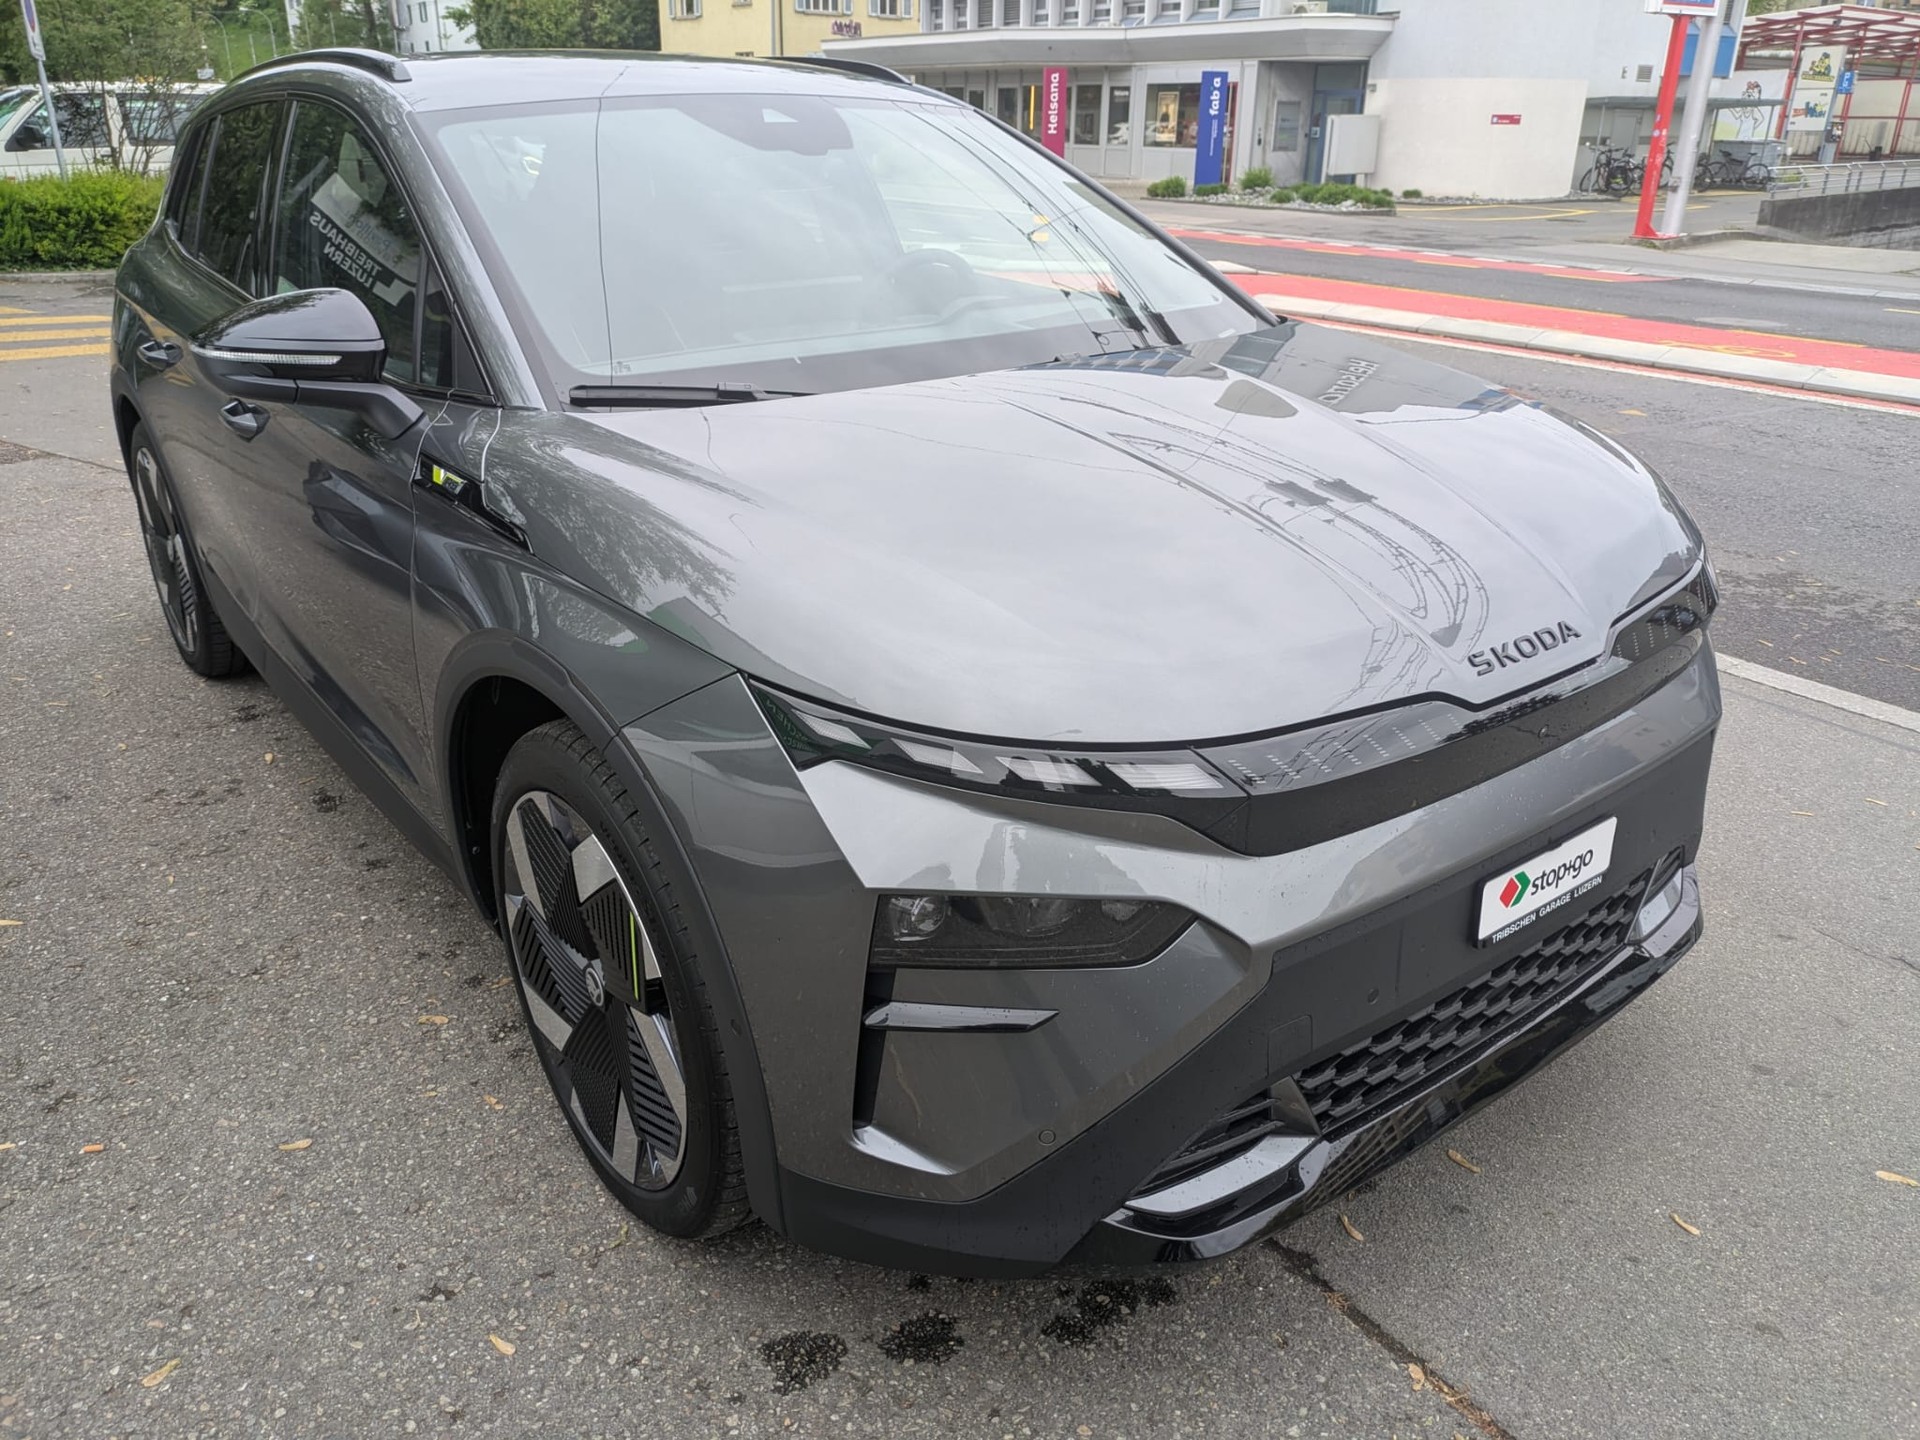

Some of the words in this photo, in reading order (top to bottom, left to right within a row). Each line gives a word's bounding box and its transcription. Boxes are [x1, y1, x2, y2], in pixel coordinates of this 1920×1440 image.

[1047, 72, 1060, 135] Helsana
[1530, 848, 1594, 896] stop+go
[1492, 911, 1537, 944] TRIBSCHEN
[1539, 894, 1572, 917] GARAGE
[1574, 874, 1603, 898] LUZERN
